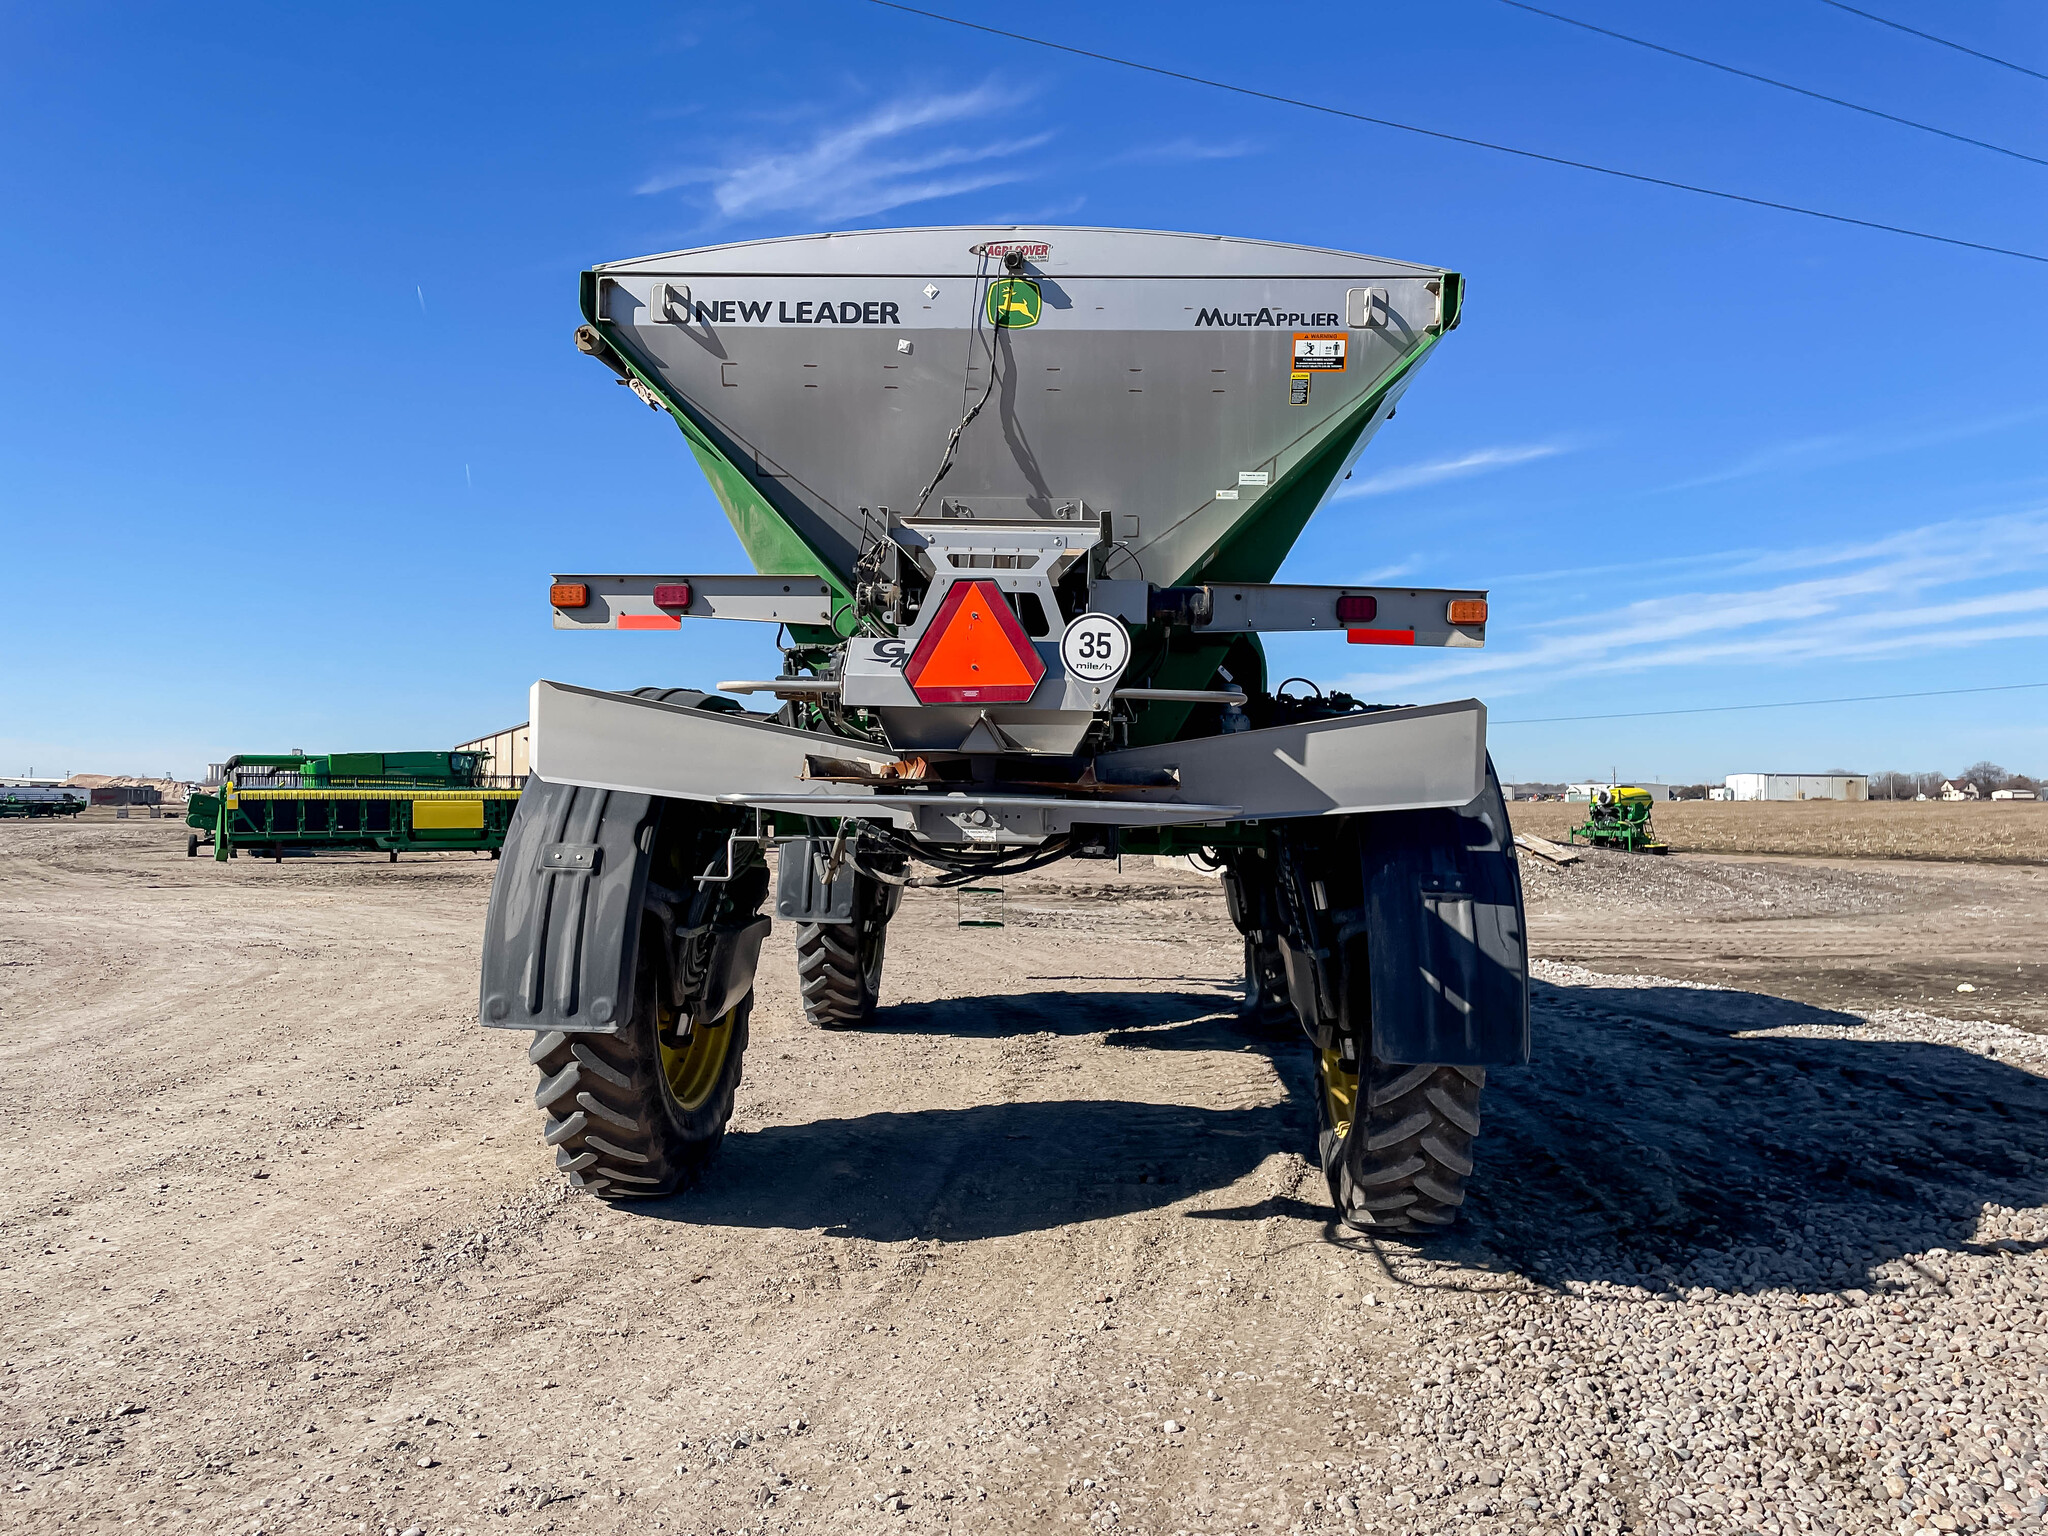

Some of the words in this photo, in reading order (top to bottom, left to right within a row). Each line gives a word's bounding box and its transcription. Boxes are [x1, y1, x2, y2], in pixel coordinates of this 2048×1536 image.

[695, 300, 772, 323] NEW
[779, 301, 900, 324] LEADER
[1079, 631, 1112, 659] 35
[1076, 662, 1112, 671] mile/h
